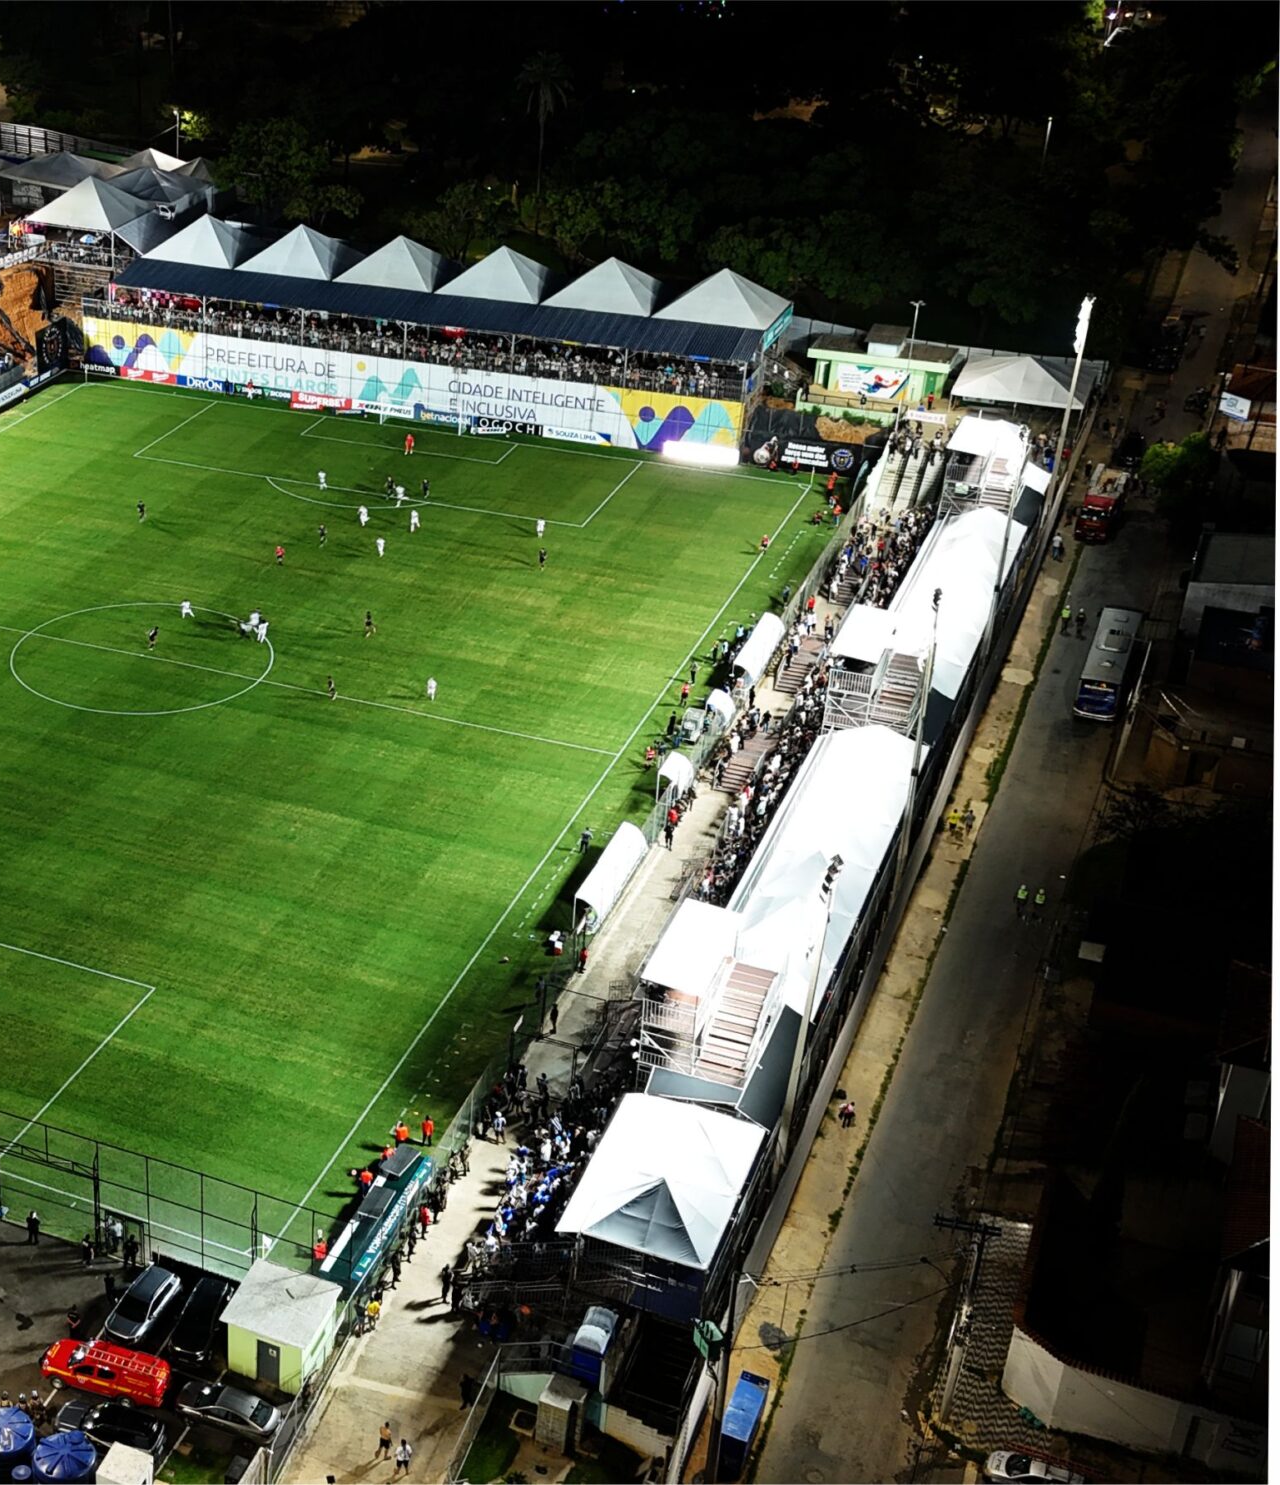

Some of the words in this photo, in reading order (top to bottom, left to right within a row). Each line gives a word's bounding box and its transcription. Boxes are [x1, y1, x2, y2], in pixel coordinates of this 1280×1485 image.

[79, 362, 116, 374] heatmap
[206, 346, 308, 376] PREFEITURA
[314, 361, 337, 379] DE
[205, 366, 269, 389] MONTES
[274, 374, 339, 396] CLAROS
[298, 393, 346, 407] SUPERBET
[448, 380, 504, 401] CIDADE
[507, 386, 605, 413] INTELIGENTE
[421, 411, 470, 425] betnacioal
[462, 401, 537, 422] INCLUSIVA
